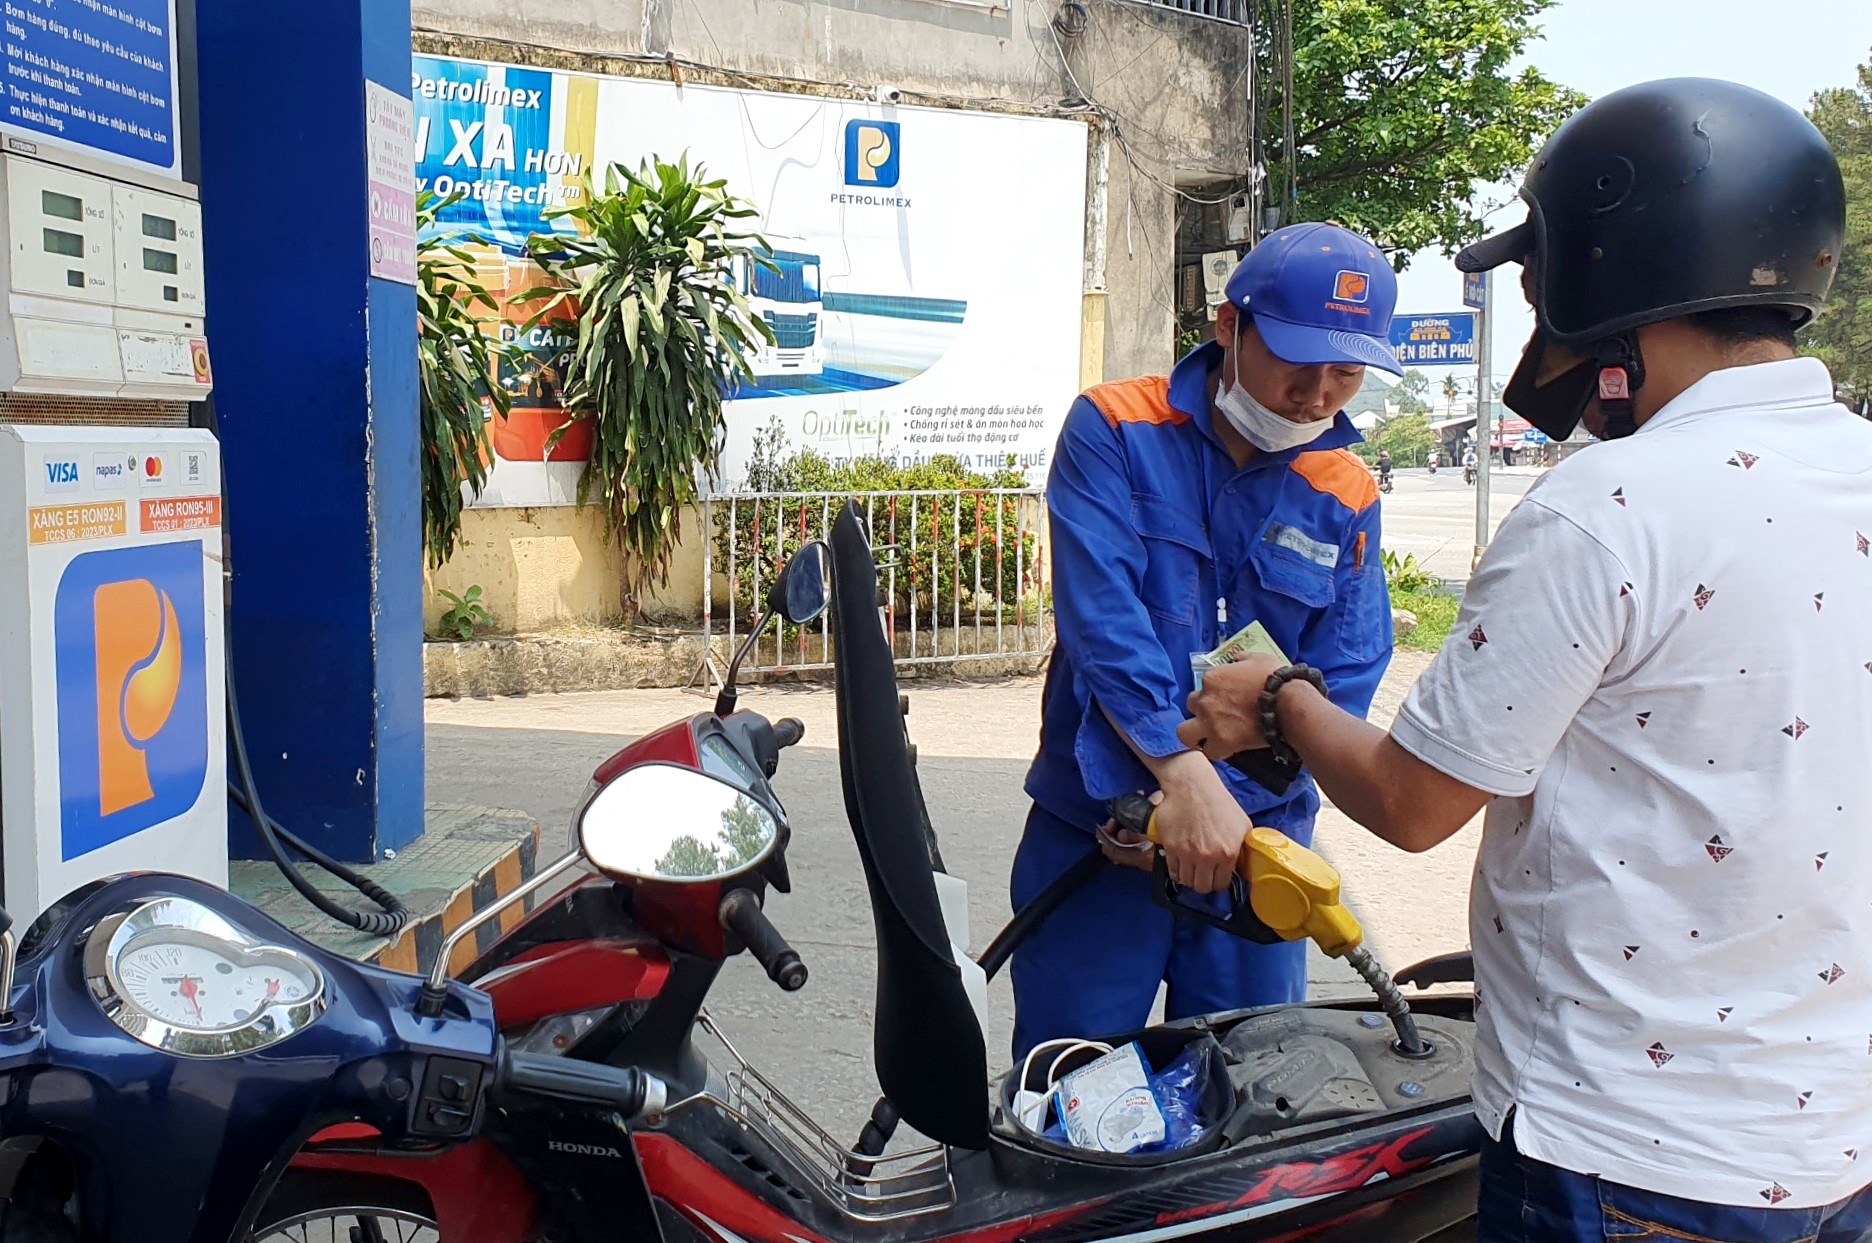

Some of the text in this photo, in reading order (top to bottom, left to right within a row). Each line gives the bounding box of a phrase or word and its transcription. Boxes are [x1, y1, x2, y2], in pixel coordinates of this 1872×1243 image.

[6, 2, 25, 20] Bơm
[27, 10, 47, 31] hàng
[83, 32, 100, 48] theo
[25, 49, 49, 69] khách
[51, 58, 70, 78] hàng
[30, 68, 42, 83] khi
[43, 73, 64, 91] thanh
[48, 97, 70, 114] thanh
[442, 118, 516, 172] XA
[524, 148, 582, 176] HƠN
[830, 193, 912, 208] PETROLIMEX
[1411, 318, 1450, 328] ĐƯỜNG
[1419, 341, 1447, 359] BIÊN
[1449, 338, 1473, 359] PHỦ
[910, 405, 933, 417] Công
[935, 405, 958, 417] nghệ
[1006, 405, 1025, 415] siêu
[802, 408, 891, 442] OptiTech
[910, 418, 939, 431] Chống
[966, 418, 973, 429] &
[1028, 418, 1045, 430] học
[910, 433, 928, 443] Kéo
[967, 432, 982, 444] thọ
[984, 432, 1006, 444] động
[975, 450, 1006, 468] THIÊ
[1020, 447, 1046, 467] HUẾ
[45, 462, 79, 483] VISA
[96, 465, 117, 478] napas
[33, 505, 123, 529] XĂNG E5 RON92-II
[149, 500, 213, 519] XĂNG RON95-III
[152, 519, 170, 531] TCCS
[44, 529, 66, 542] TCCS
[548, 1140, 623, 1158] HONDA
